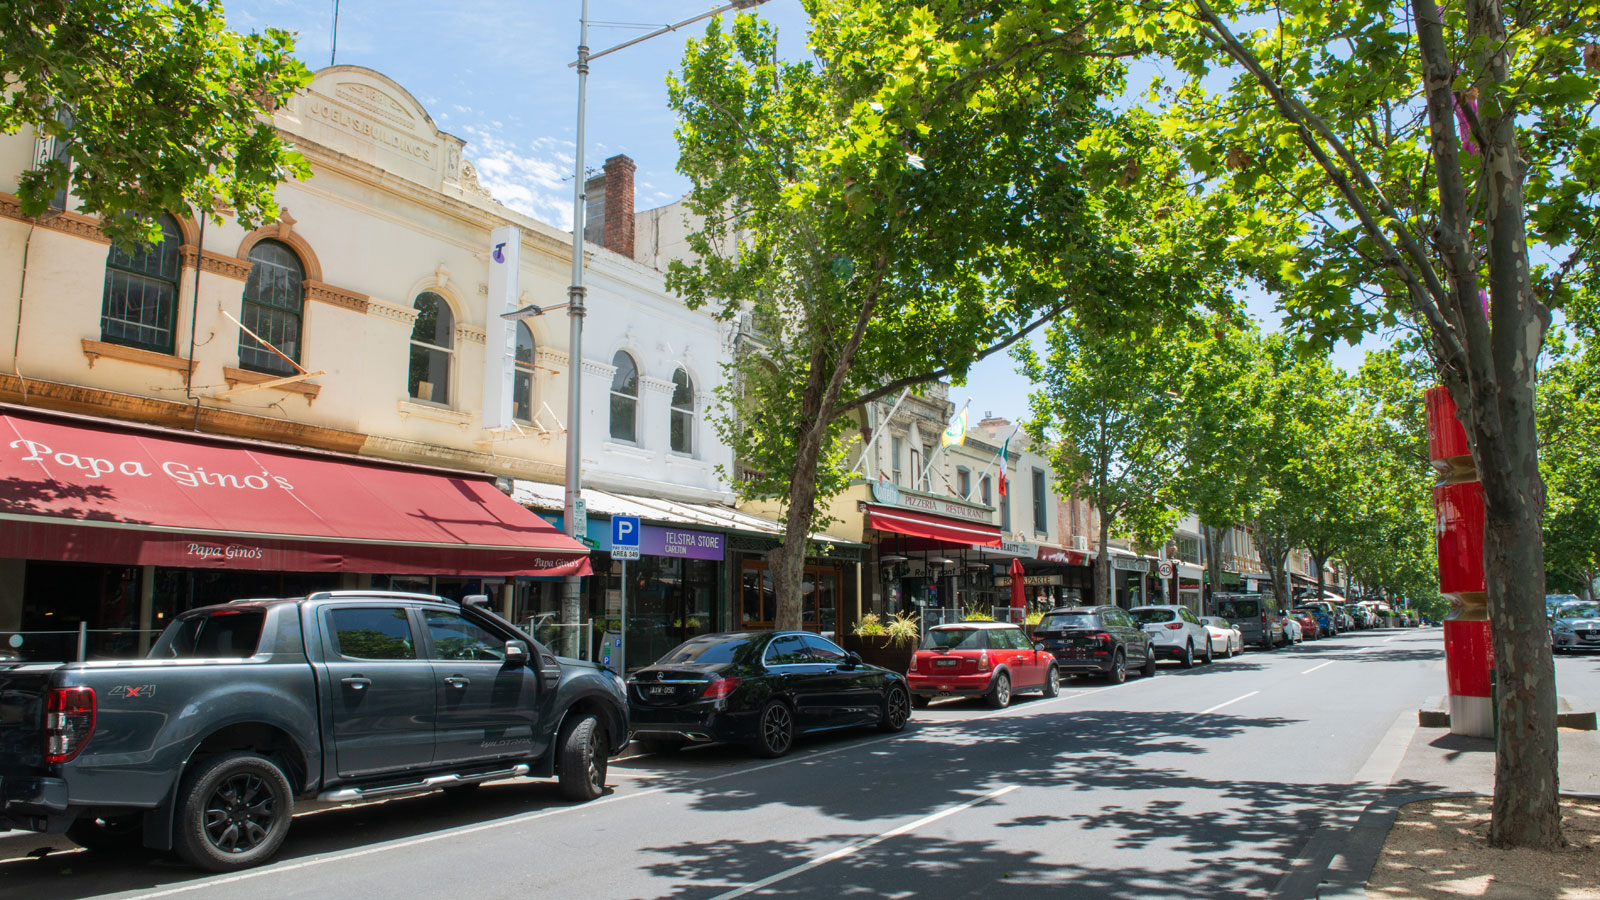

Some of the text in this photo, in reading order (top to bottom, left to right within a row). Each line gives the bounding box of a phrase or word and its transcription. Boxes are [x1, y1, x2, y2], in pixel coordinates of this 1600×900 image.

[9, 439, 295, 491] Papa Gino's
[905, 496, 985, 520] PIZZERIA RESTAURANT
[618, 521, 633, 541] P
[665, 532, 720, 549] TELSTRA STORE
[187, 543, 263, 560] Papa Gino's
[664, 545, 687, 555] CARLTON
[534, 557, 579, 570] Papa Gino's
